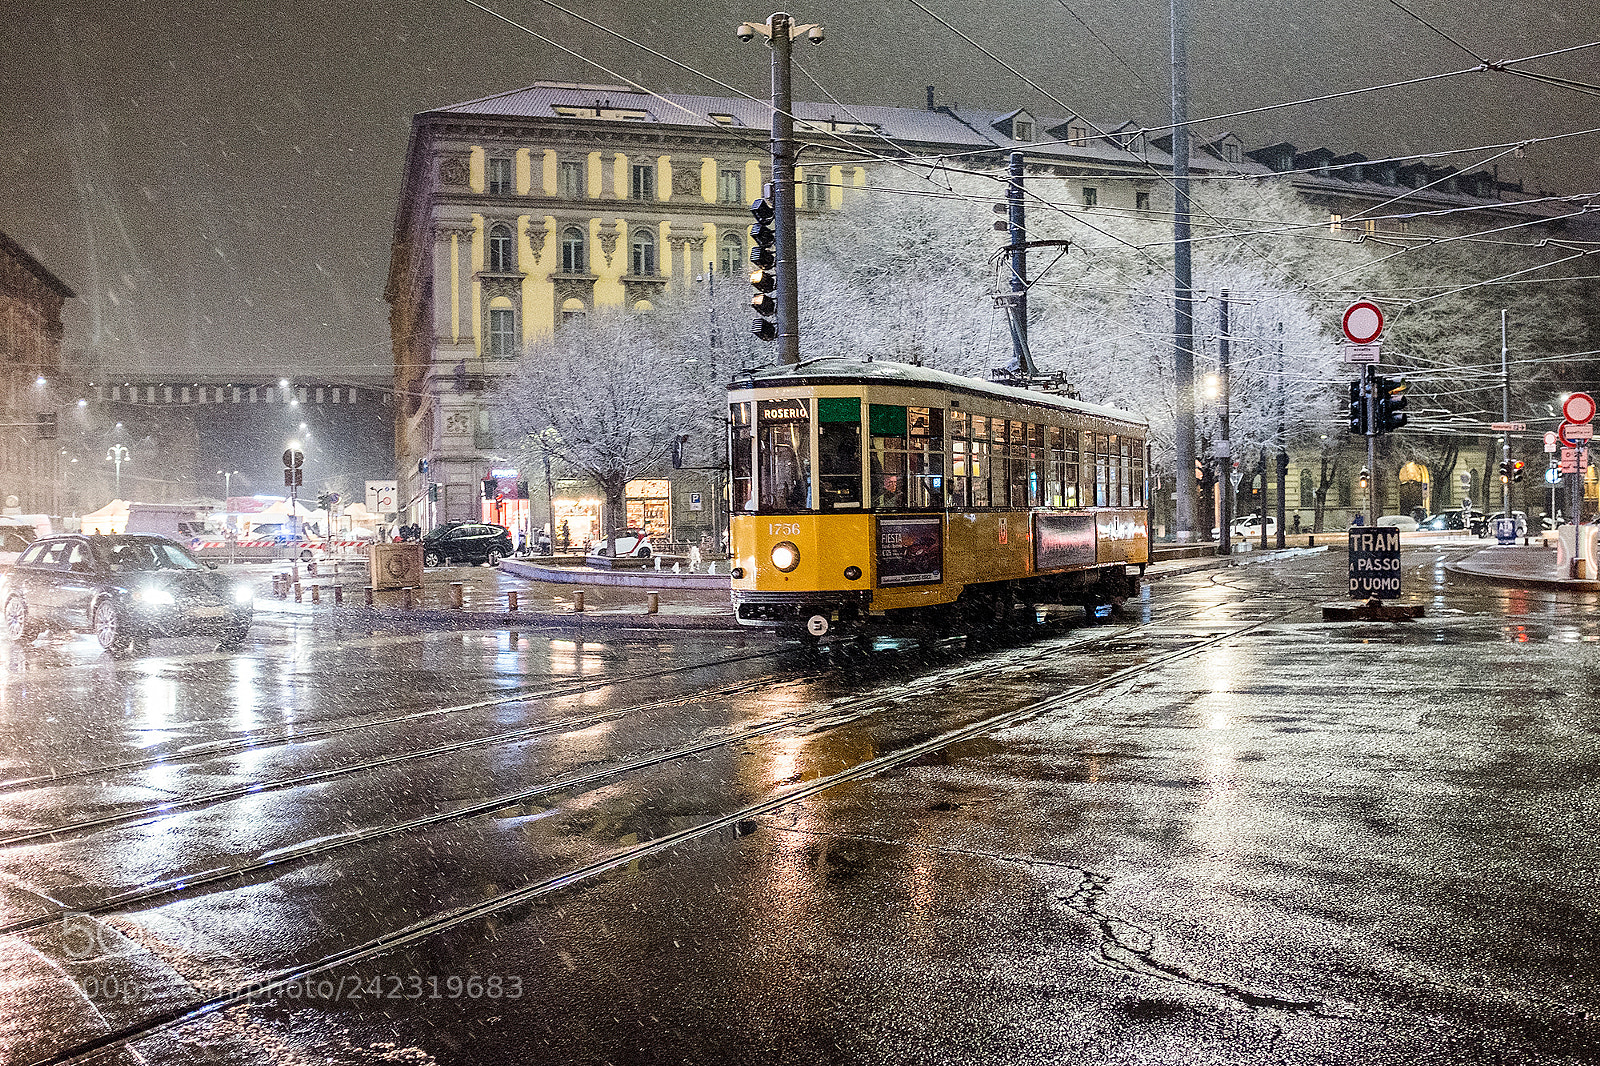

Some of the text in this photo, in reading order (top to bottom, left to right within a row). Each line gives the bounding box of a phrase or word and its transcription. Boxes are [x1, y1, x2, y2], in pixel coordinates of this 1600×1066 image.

[764, 408, 808, 419] ROSERIO
[769, 523, 801, 536] 1756
[881, 533, 903, 544] FIESTA
[1350, 533, 1399, 552] TRAM
[1350, 559, 1400, 572] A PASSO
[1349, 577, 1400, 591] D'UOMO
